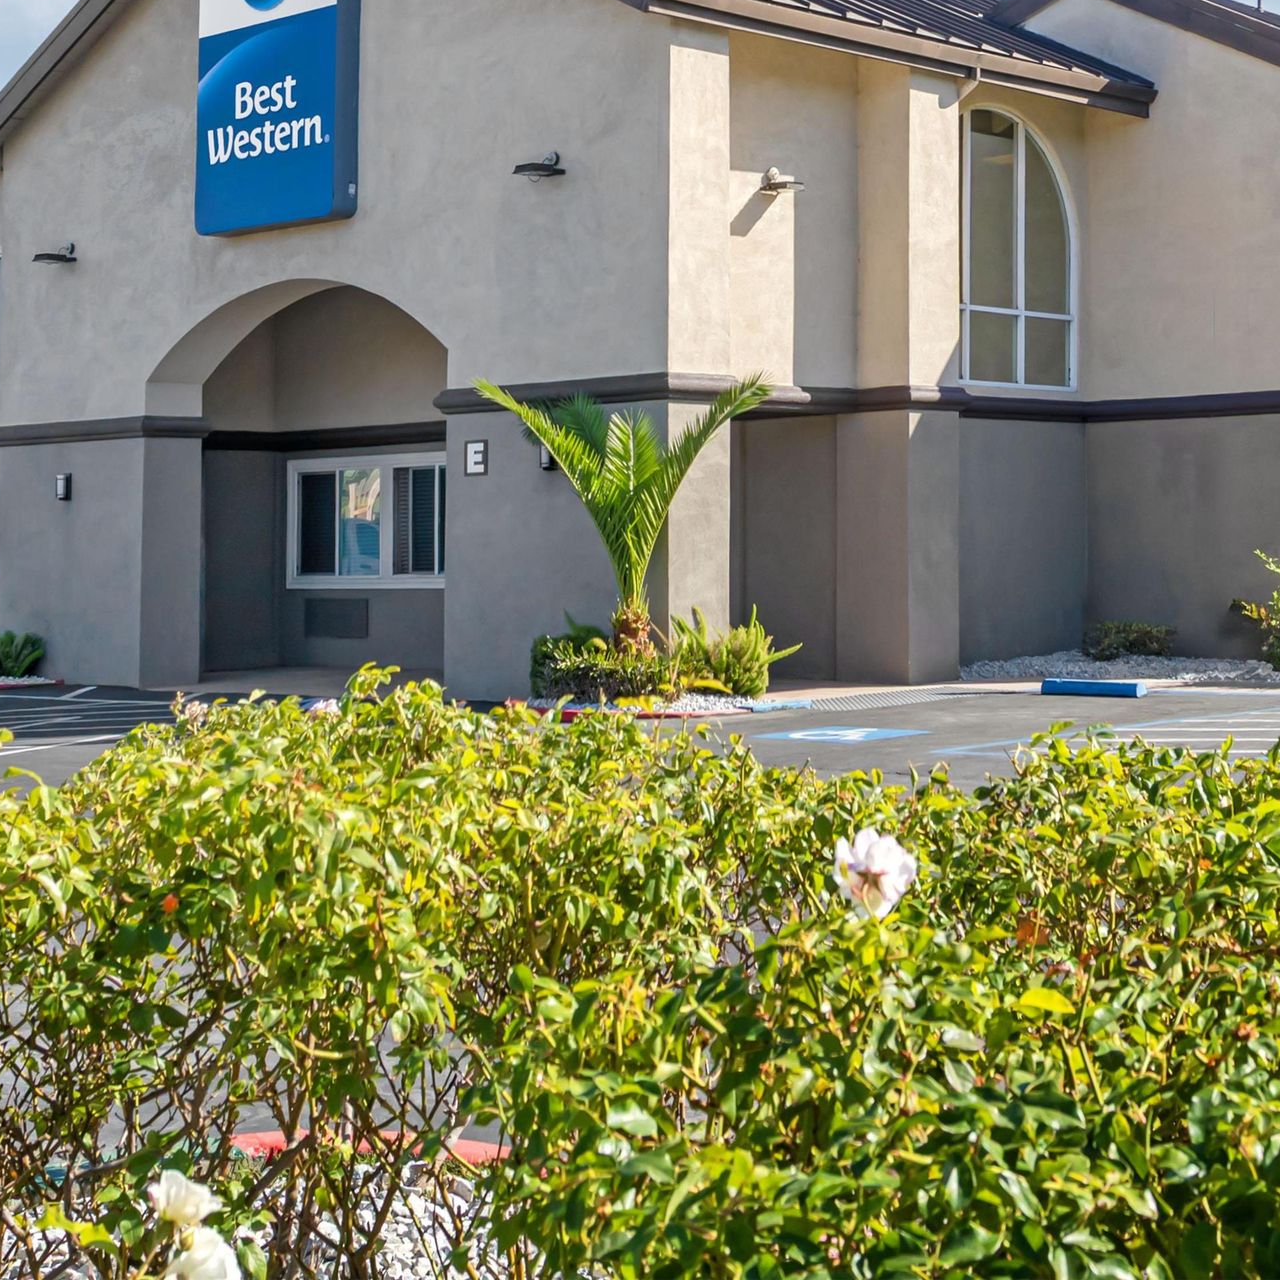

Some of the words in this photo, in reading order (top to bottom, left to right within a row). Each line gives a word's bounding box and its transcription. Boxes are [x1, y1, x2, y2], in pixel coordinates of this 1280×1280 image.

[235, 75, 297, 120] Best
[207, 114, 323, 166] Western
[466, 442, 485, 474] E
